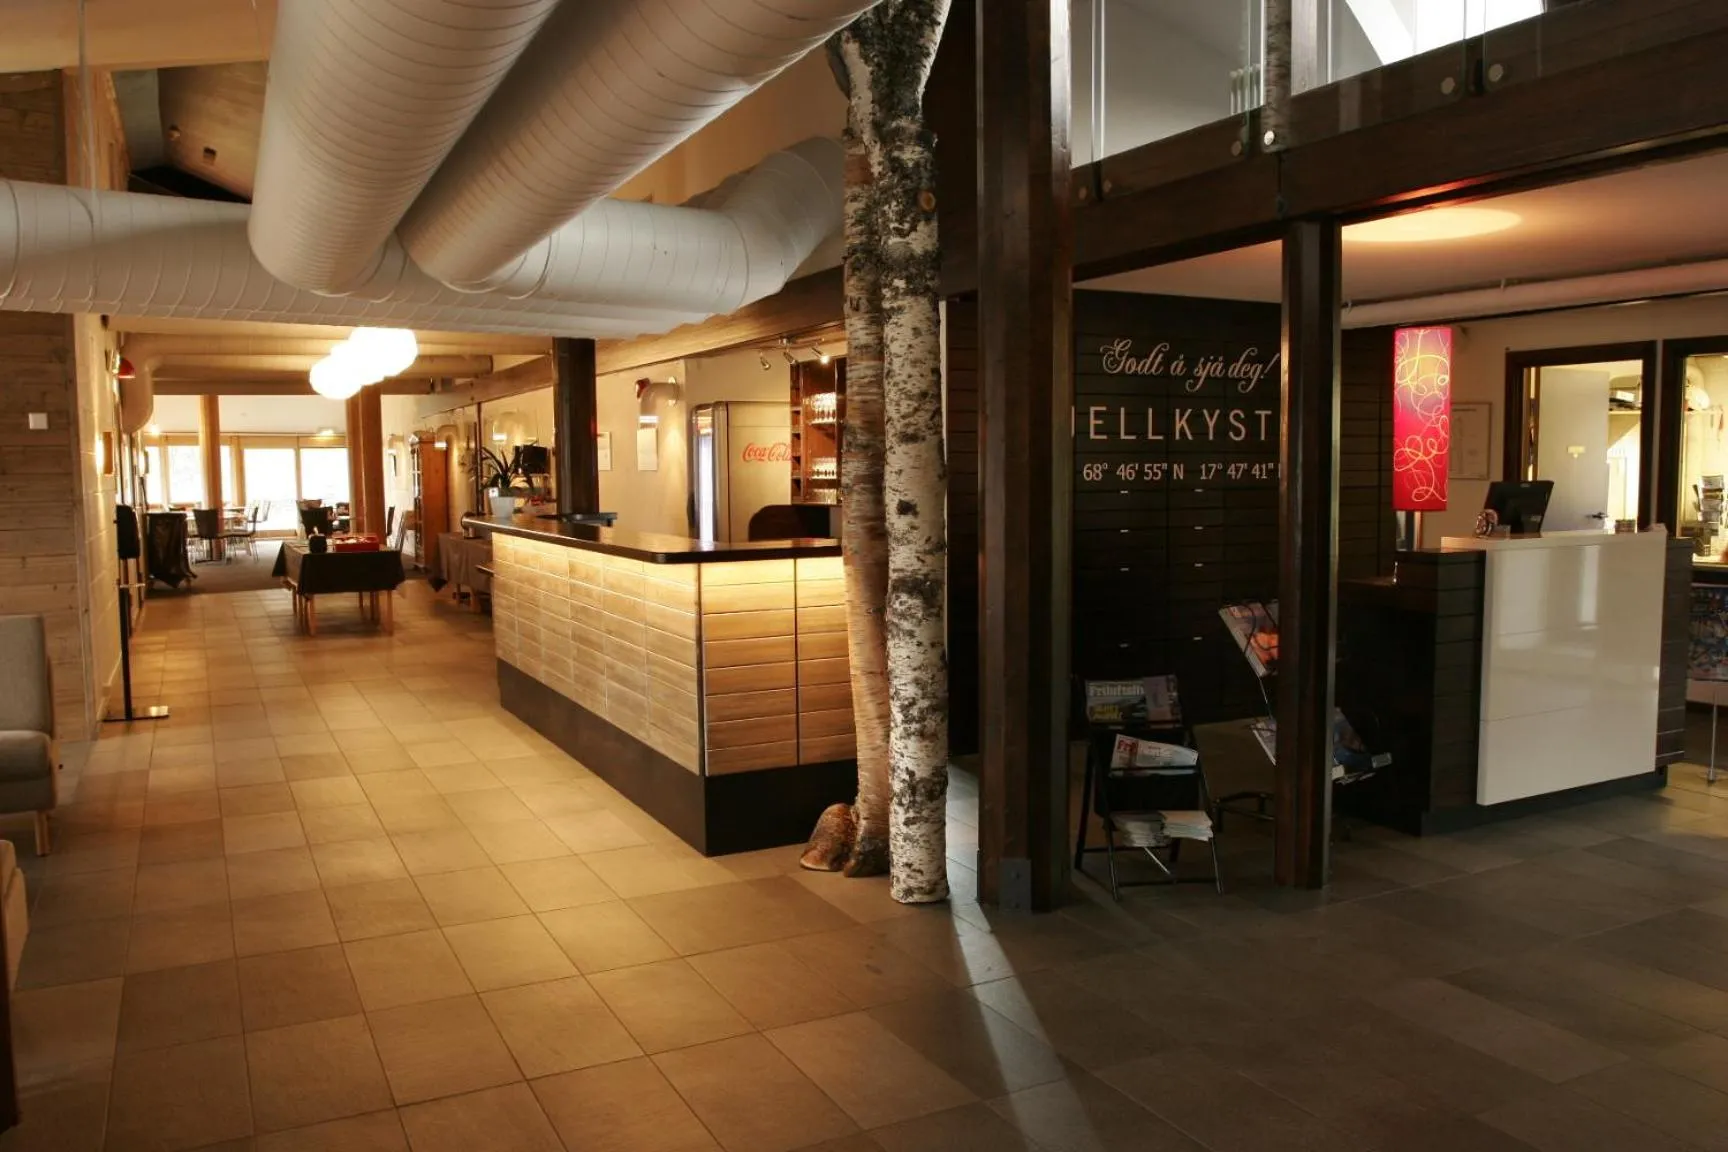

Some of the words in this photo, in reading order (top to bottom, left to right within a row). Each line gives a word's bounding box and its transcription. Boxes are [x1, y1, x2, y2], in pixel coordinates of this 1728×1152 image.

[1100, 338, 1170, 375] Godt
[1170, 354, 1187, 376] å
[1185, 356, 1226, 393] sjå
[1227, 347, 1280, 394] deg!
[1083, 462, 1108, 481] 68°
[1116, 462, 1139, 481] 46'
[1173, 463, 1184, 480] N
[1200, 463, 1223, 480] 17°
[1227, 463, 1248, 480] 47'
